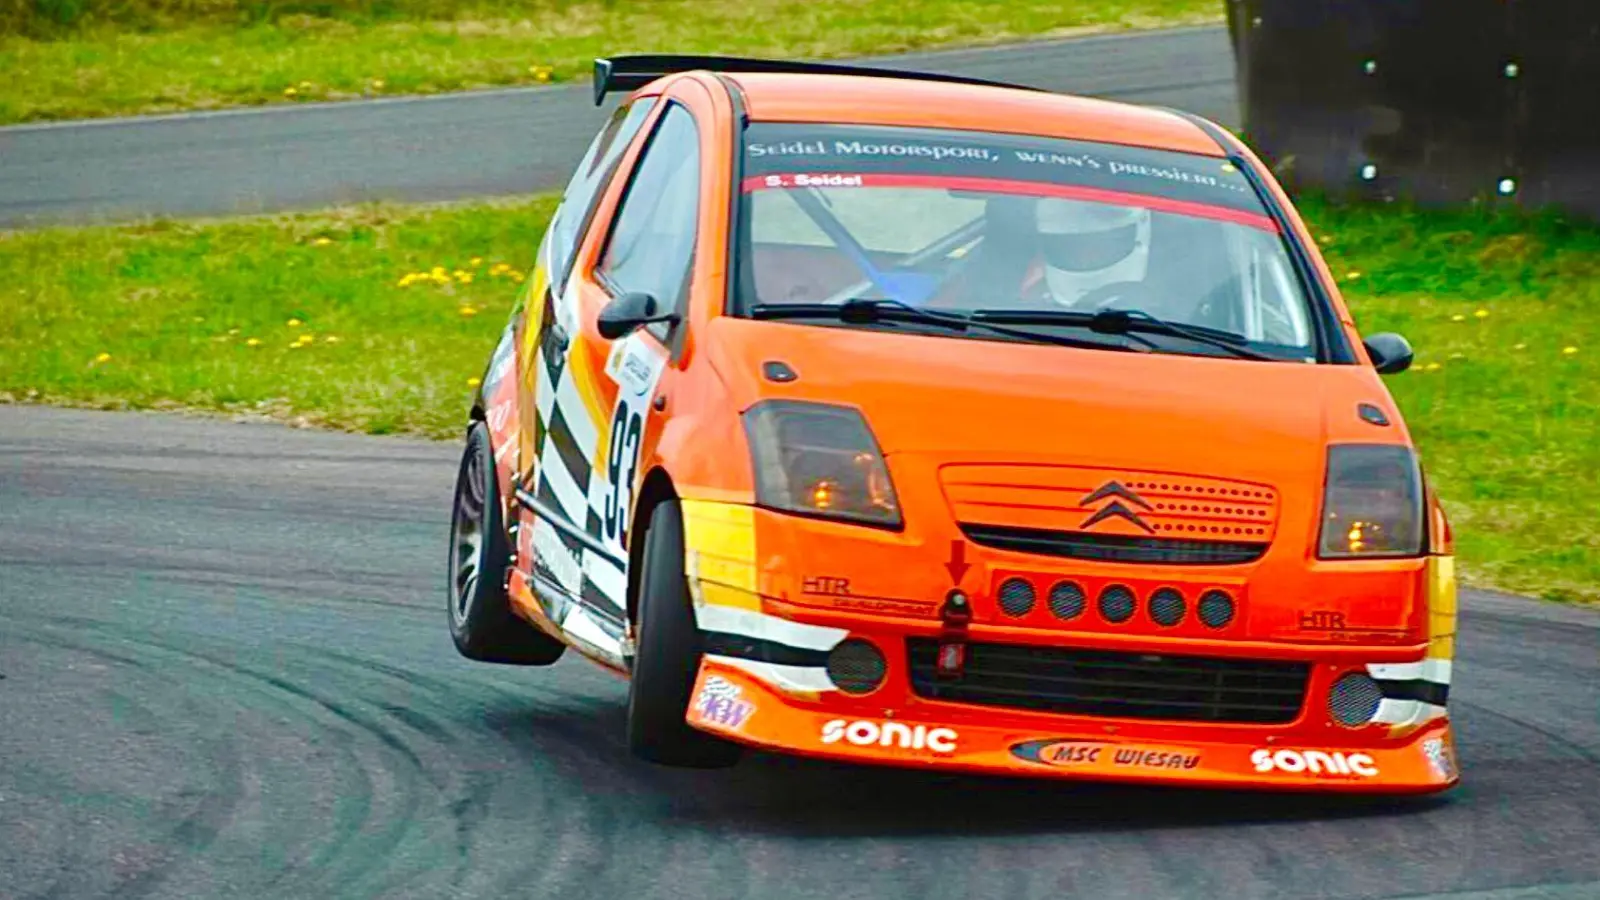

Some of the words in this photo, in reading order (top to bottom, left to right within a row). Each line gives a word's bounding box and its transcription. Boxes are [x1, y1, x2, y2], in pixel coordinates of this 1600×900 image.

[764, 175, 789, 187] S.
[793, 174, 864, 187] Seidel
[605, 399, 642, 551] 93
[802, 575, 851, 594] HTR
[1298, 609, 1347, 629] HTR
[820, 718, 959, 753] SONIC
[1053, 746, 1102, 763] MSC
[1113, 749, 1201, 769] WIESAU
[1250, 749, 1380, 776] SONIC
